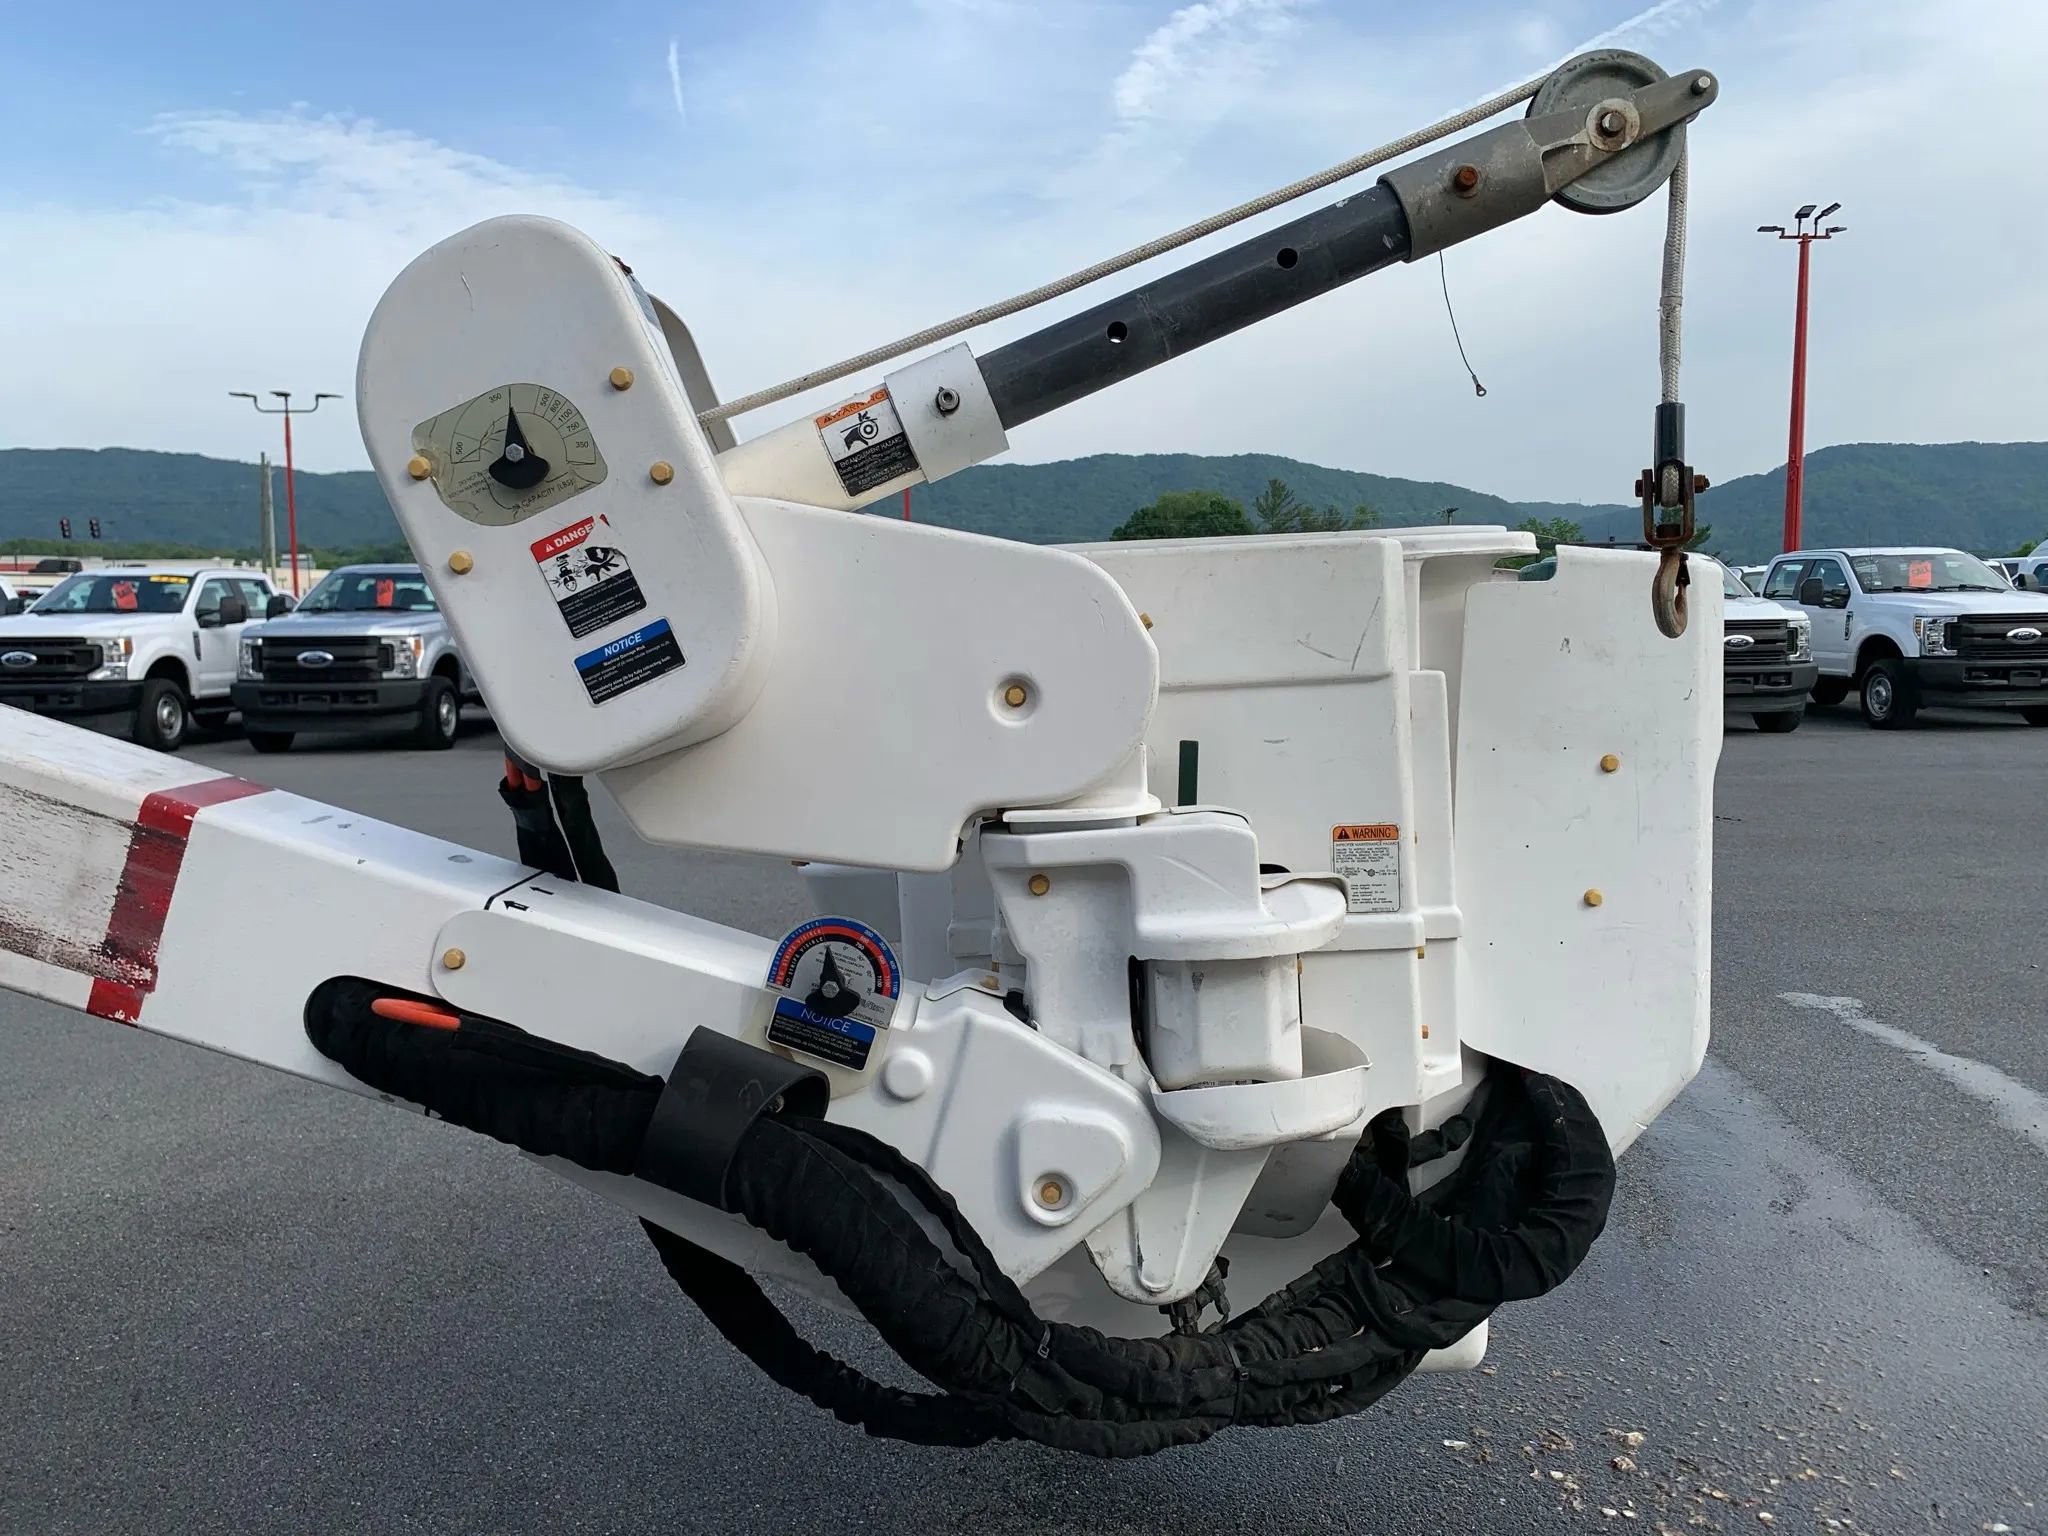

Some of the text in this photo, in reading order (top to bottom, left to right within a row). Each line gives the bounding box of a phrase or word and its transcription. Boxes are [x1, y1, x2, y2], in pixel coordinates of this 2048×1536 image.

[489, 392, 502, 403] 350
[540, 393, 550, 406] 500
[831, 391, 885, 417] WARNNG
[550, 399, 561, 413] 800
[558, 408, 573, 423] 1100
[566, 421, 580, 432] 750
[455, 441, 464, 455] 500
[575, 441, 589, 449] 350
[520, 487, 555, 508] CAPACITY
[554, 523, 596, 547] DANGE
[604, 632, 642, 657] NOTICE
[1351, 827, 1391, 839] WARNING
